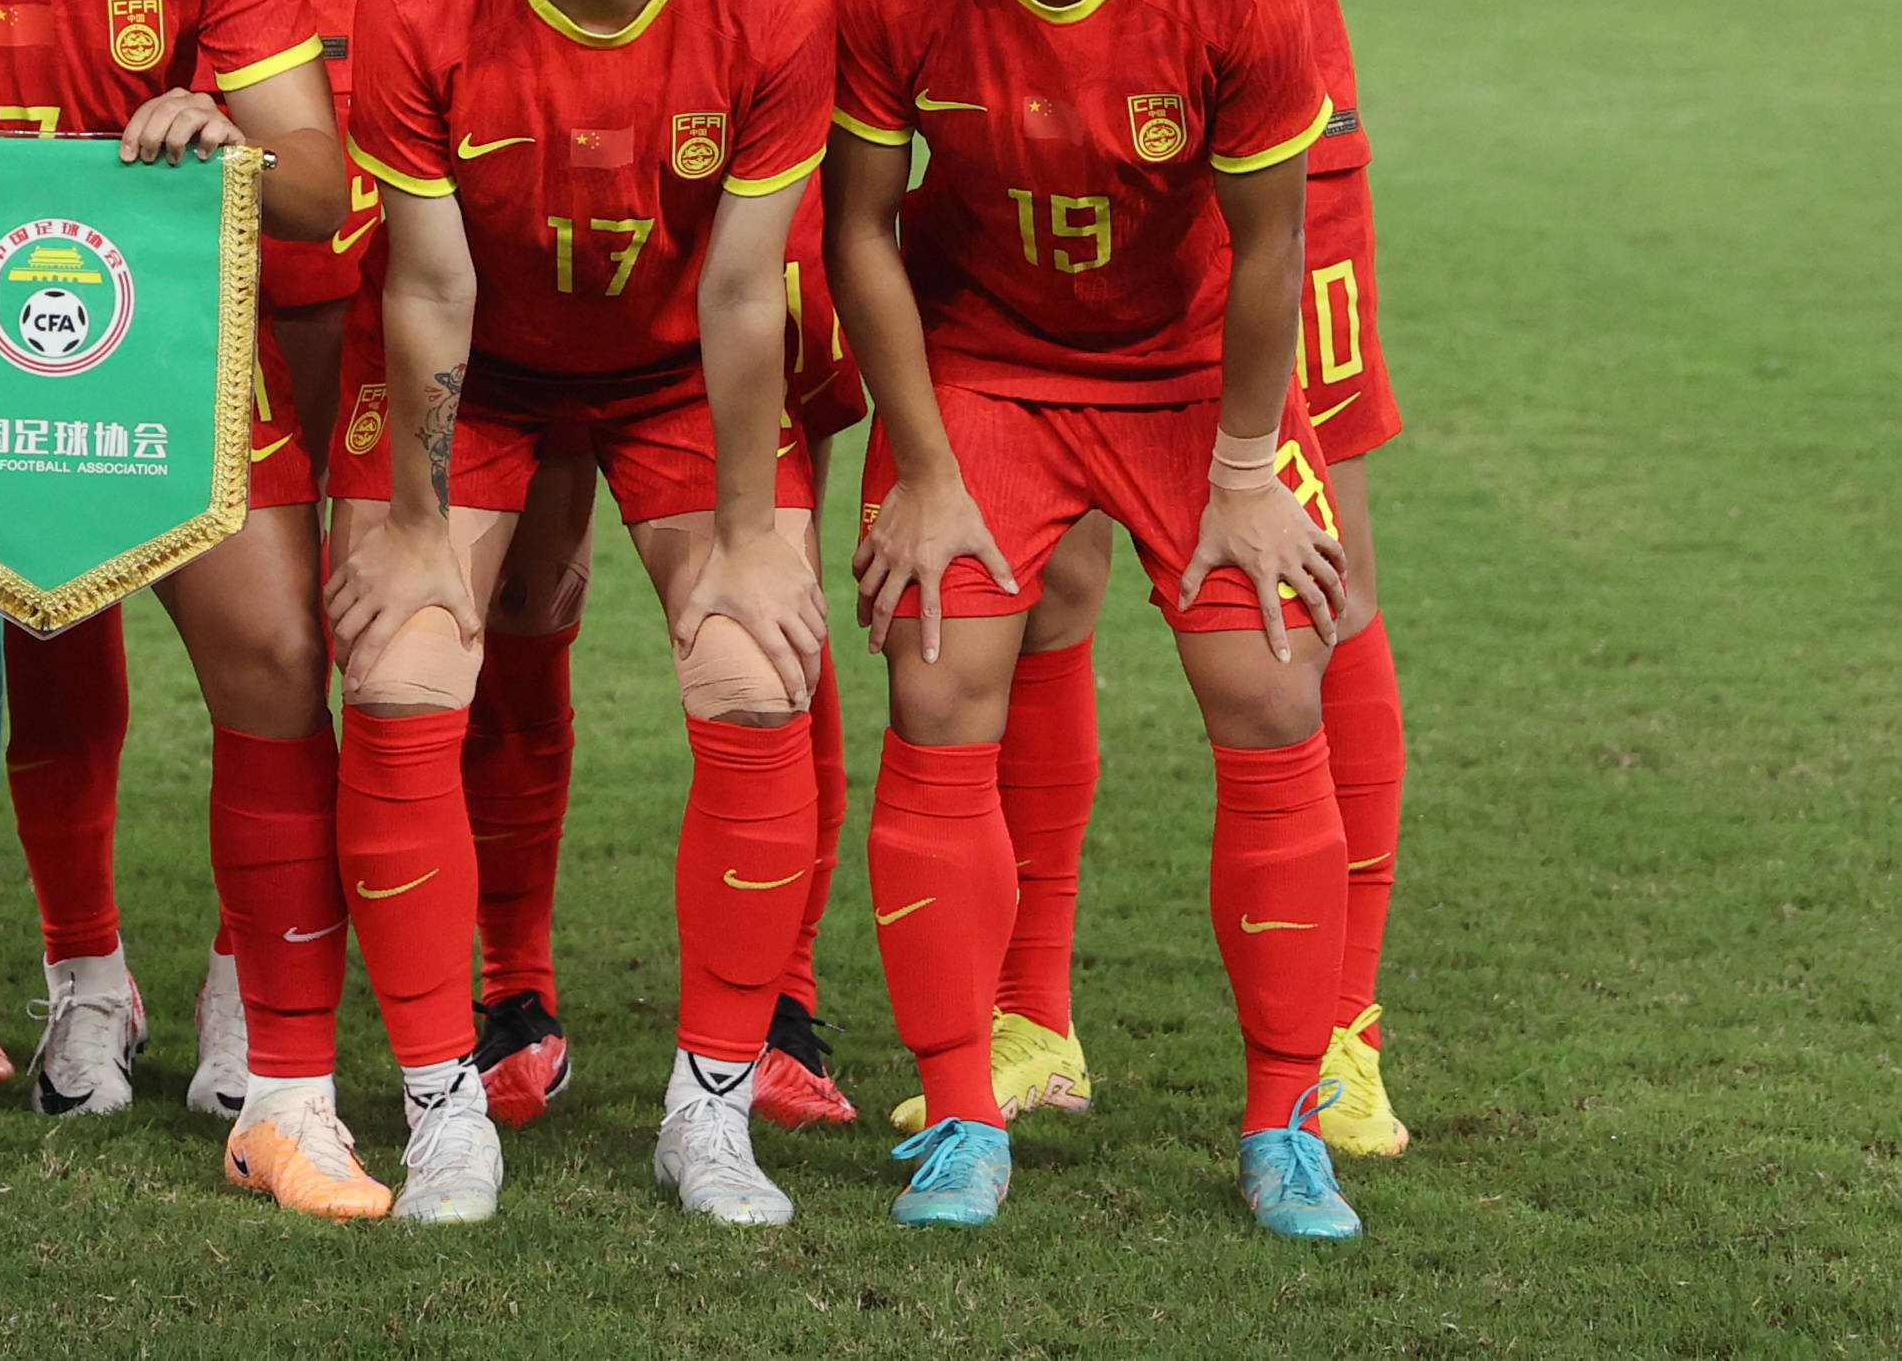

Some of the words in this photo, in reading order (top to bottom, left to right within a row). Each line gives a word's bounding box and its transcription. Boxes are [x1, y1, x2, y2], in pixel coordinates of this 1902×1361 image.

[113, 0, 158, 15] CFA
[1133, 97, 1178, 112] CFA
[677, 117, 721, 131] CFA
[1008, 188, 1111, 274] 19
[547, 215, 655, 296] 17
[34, 314, 76, 333] CFA
[0, 459, 71, 473] FOOTBALL
[77, 462, 169, 475] ASSOCIATION
